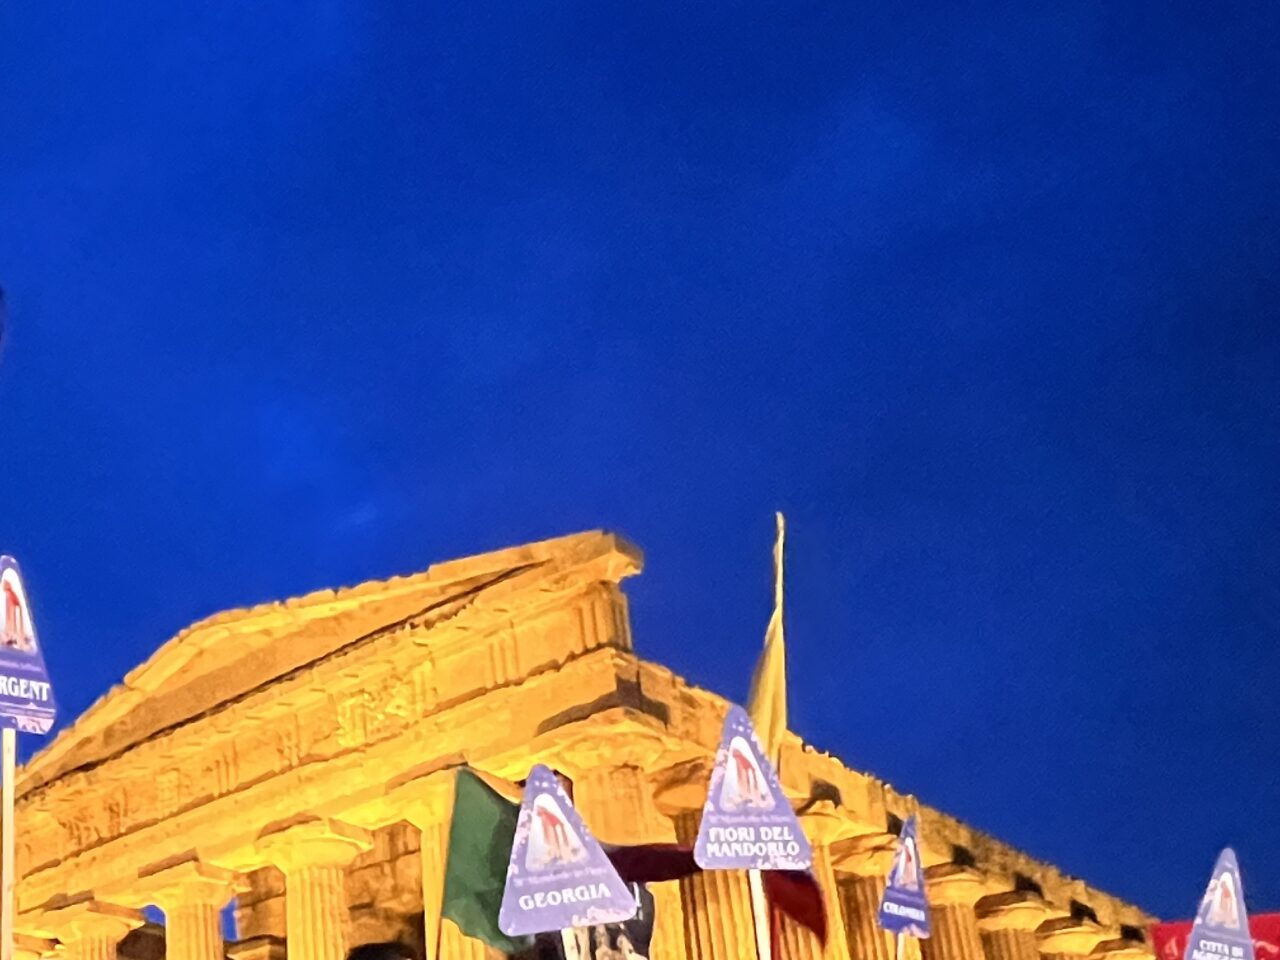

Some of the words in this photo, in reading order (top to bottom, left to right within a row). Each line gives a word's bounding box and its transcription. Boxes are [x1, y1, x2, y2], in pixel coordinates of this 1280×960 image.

[709, 826, 755, 842] FIORI
[760, 826, 794, 841] DEL
[705, 841, 800, 858] MANDORLO
[518, 882, 612, 911] GEORGIA
